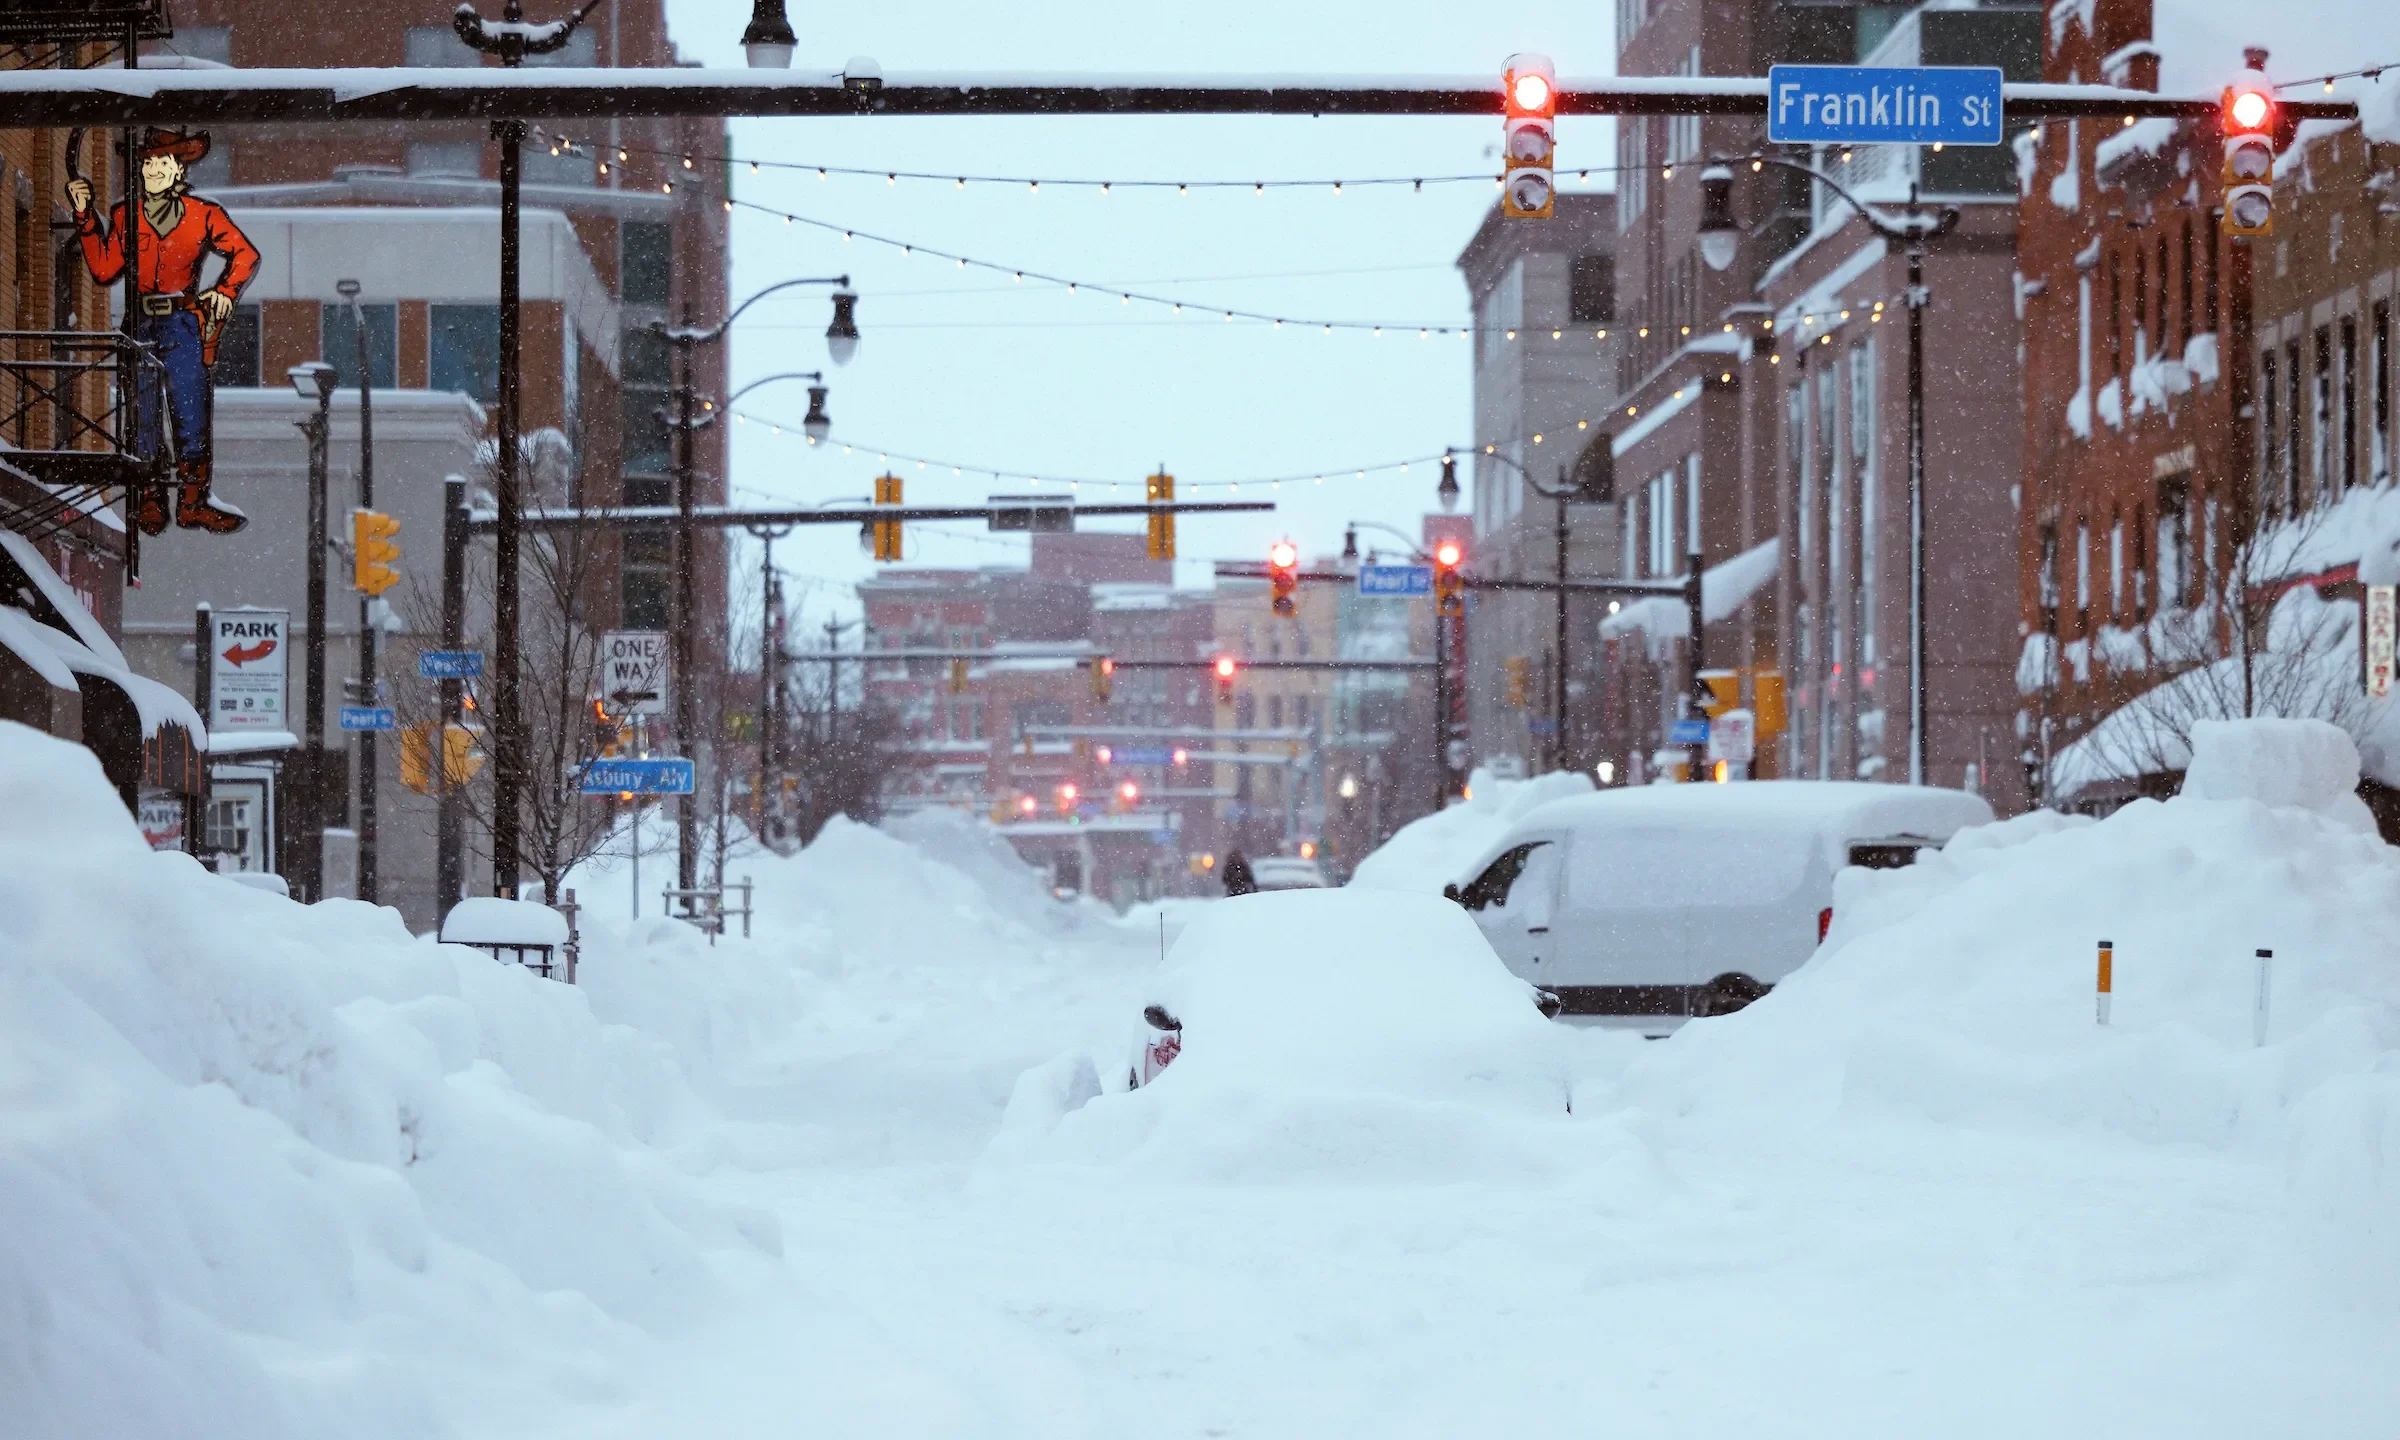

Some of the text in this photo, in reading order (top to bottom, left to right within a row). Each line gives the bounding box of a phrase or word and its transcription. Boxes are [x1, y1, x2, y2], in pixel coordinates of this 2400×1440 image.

[1778, 84, 1992, 127] Franklin St
[221, 622, 279, 638] PARK
[613, 639, 657, 658] ONE
[614, 662, 656, 680] WAY
[342, 710, 377, 726] Pearl
[583, 765, 689, 791] Asbury Aly
